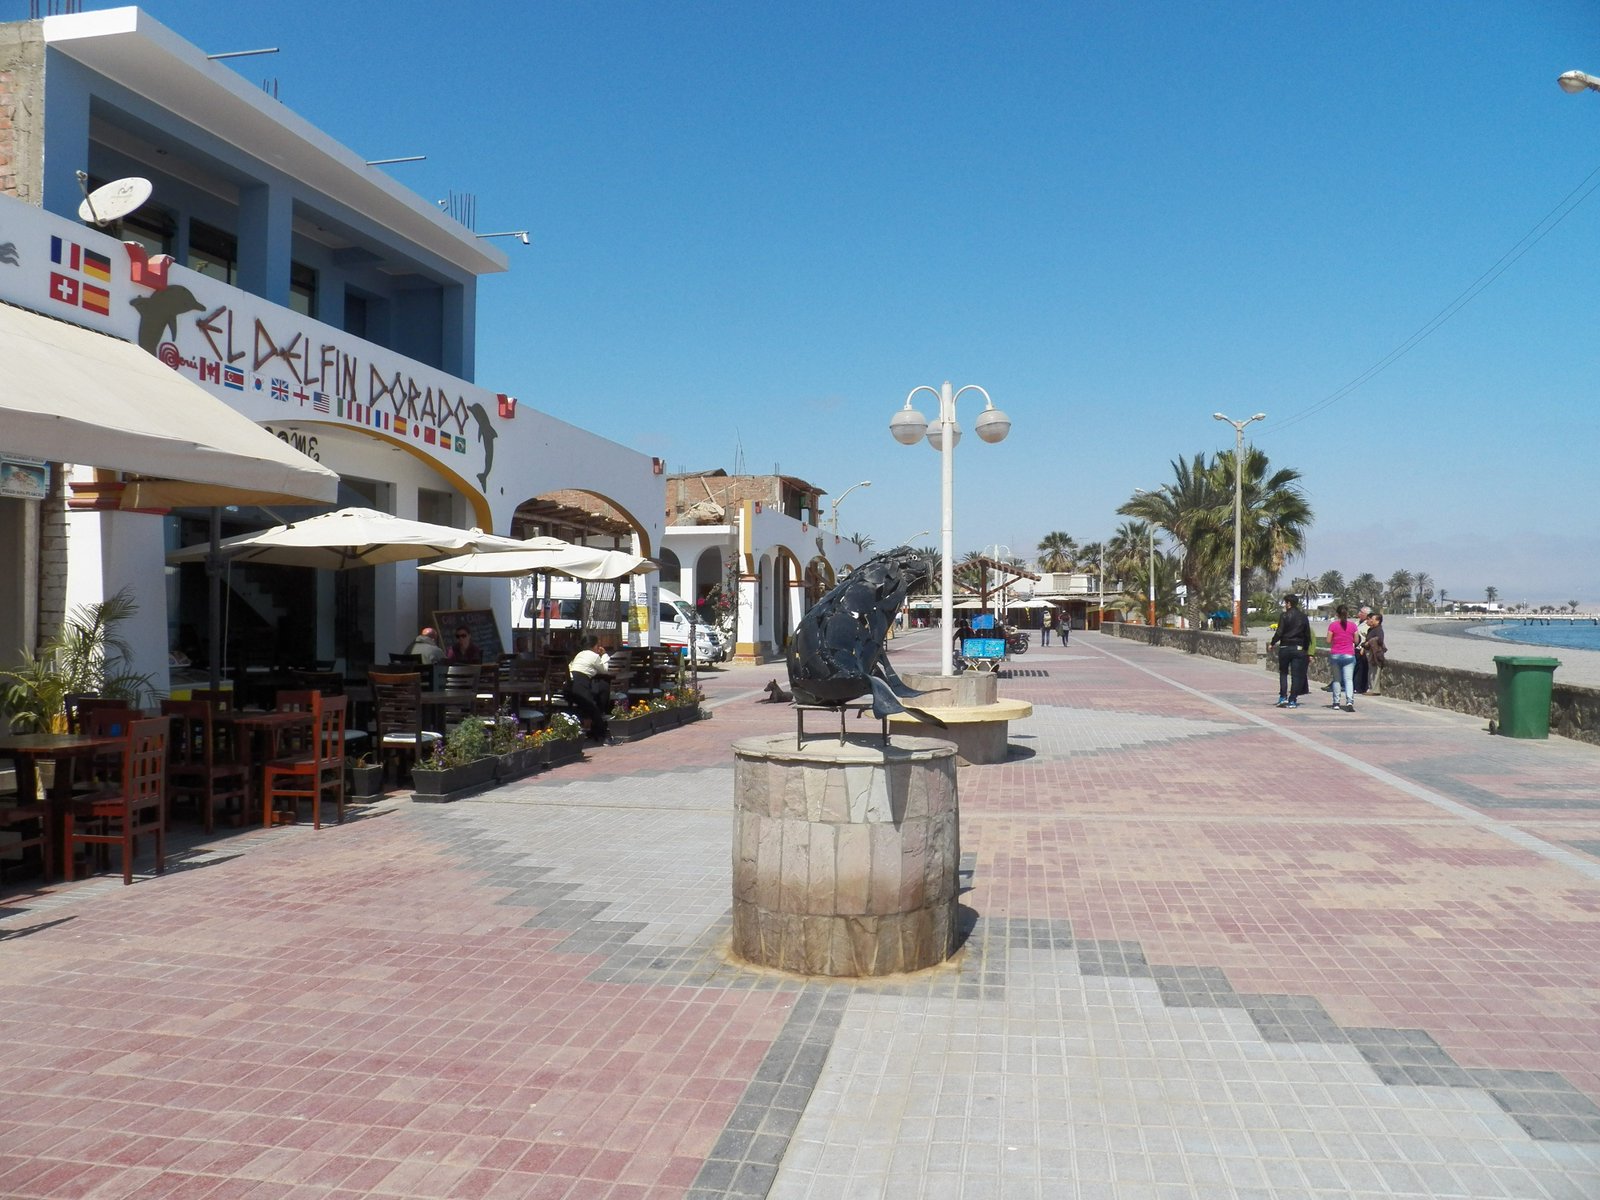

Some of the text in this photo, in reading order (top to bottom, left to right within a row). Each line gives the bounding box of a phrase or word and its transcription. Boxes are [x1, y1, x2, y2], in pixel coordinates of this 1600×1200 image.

[196, 305, 469, 435] EL DELFIN DORADO
